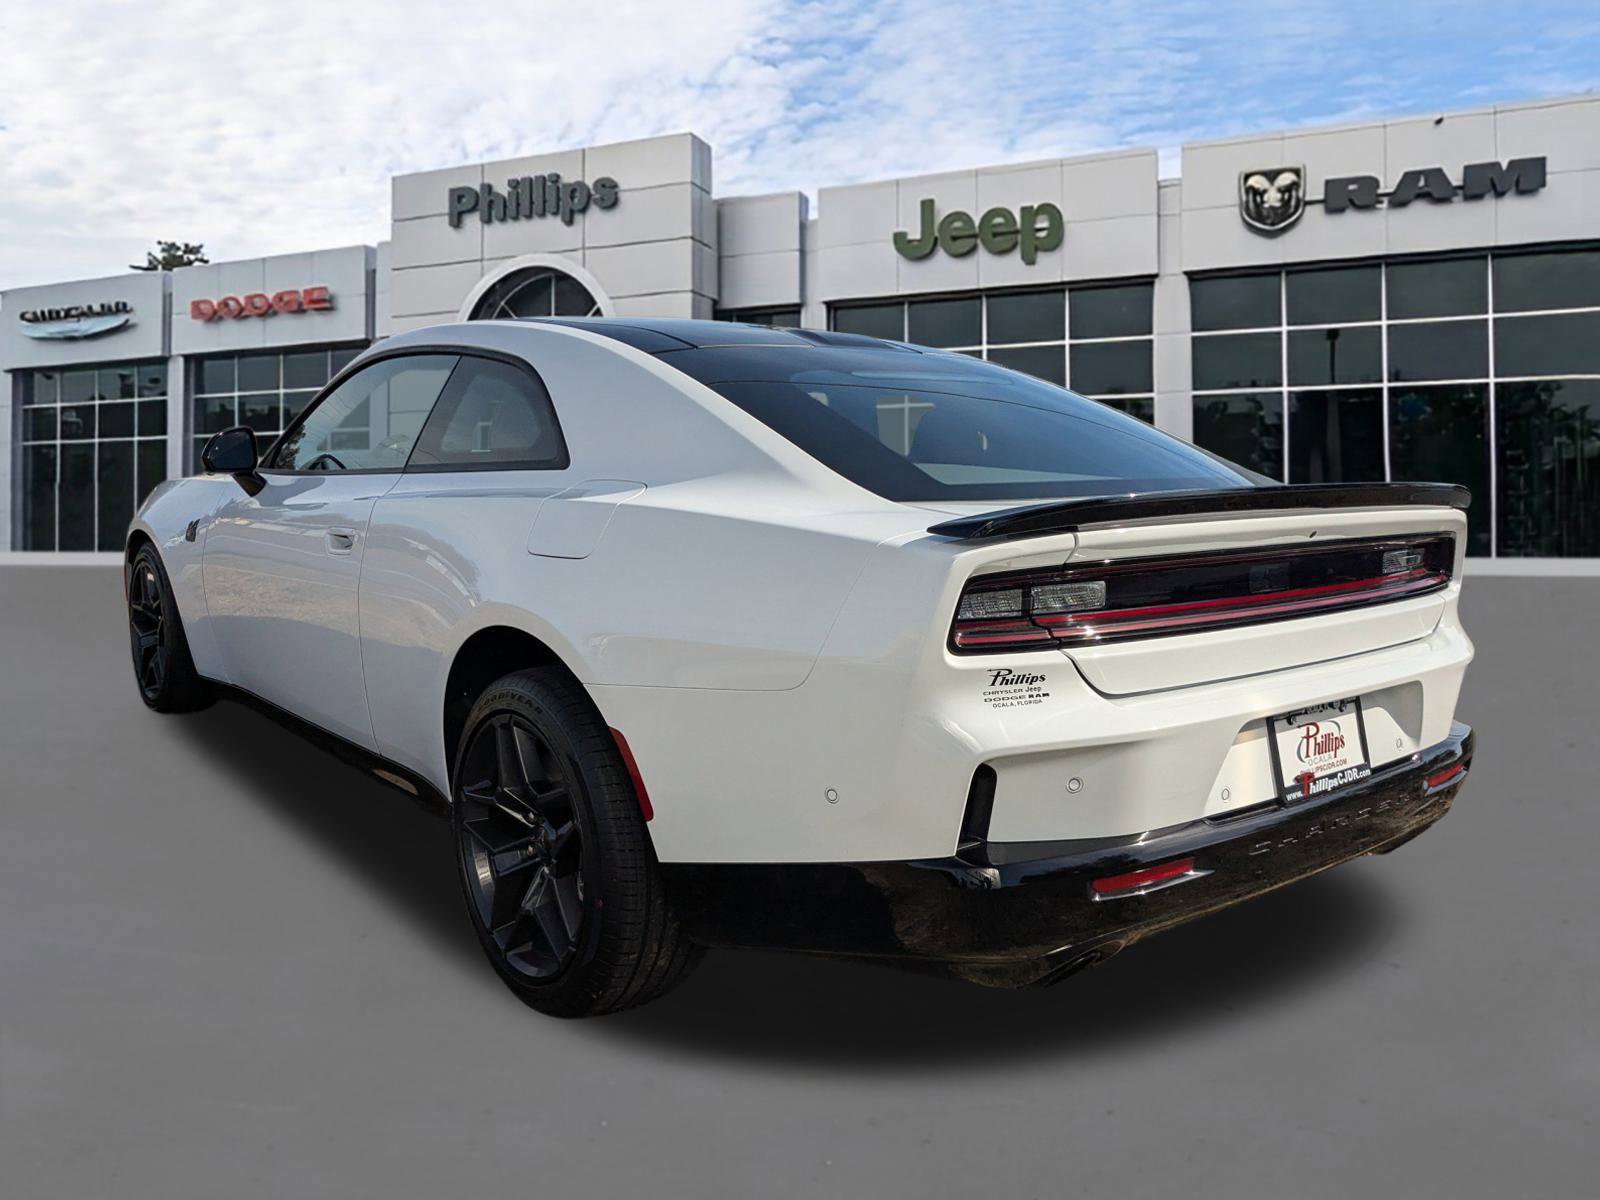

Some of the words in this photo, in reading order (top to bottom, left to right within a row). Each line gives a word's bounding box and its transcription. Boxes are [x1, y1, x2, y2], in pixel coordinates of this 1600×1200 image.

[448, 172, 620, 228] Phillips
[1325, 156, 1546, 213] RAM
[893, 199, 1064, 265] Jeep
[190, 286, 334, 321] DODGE
[986, 668, 1046, 687] Phillips
[984, 695, 1026, 703] DODGE
[1297, 721, 1345, 759] Phillips
[1308, 754, 1333, 766] OCALA
